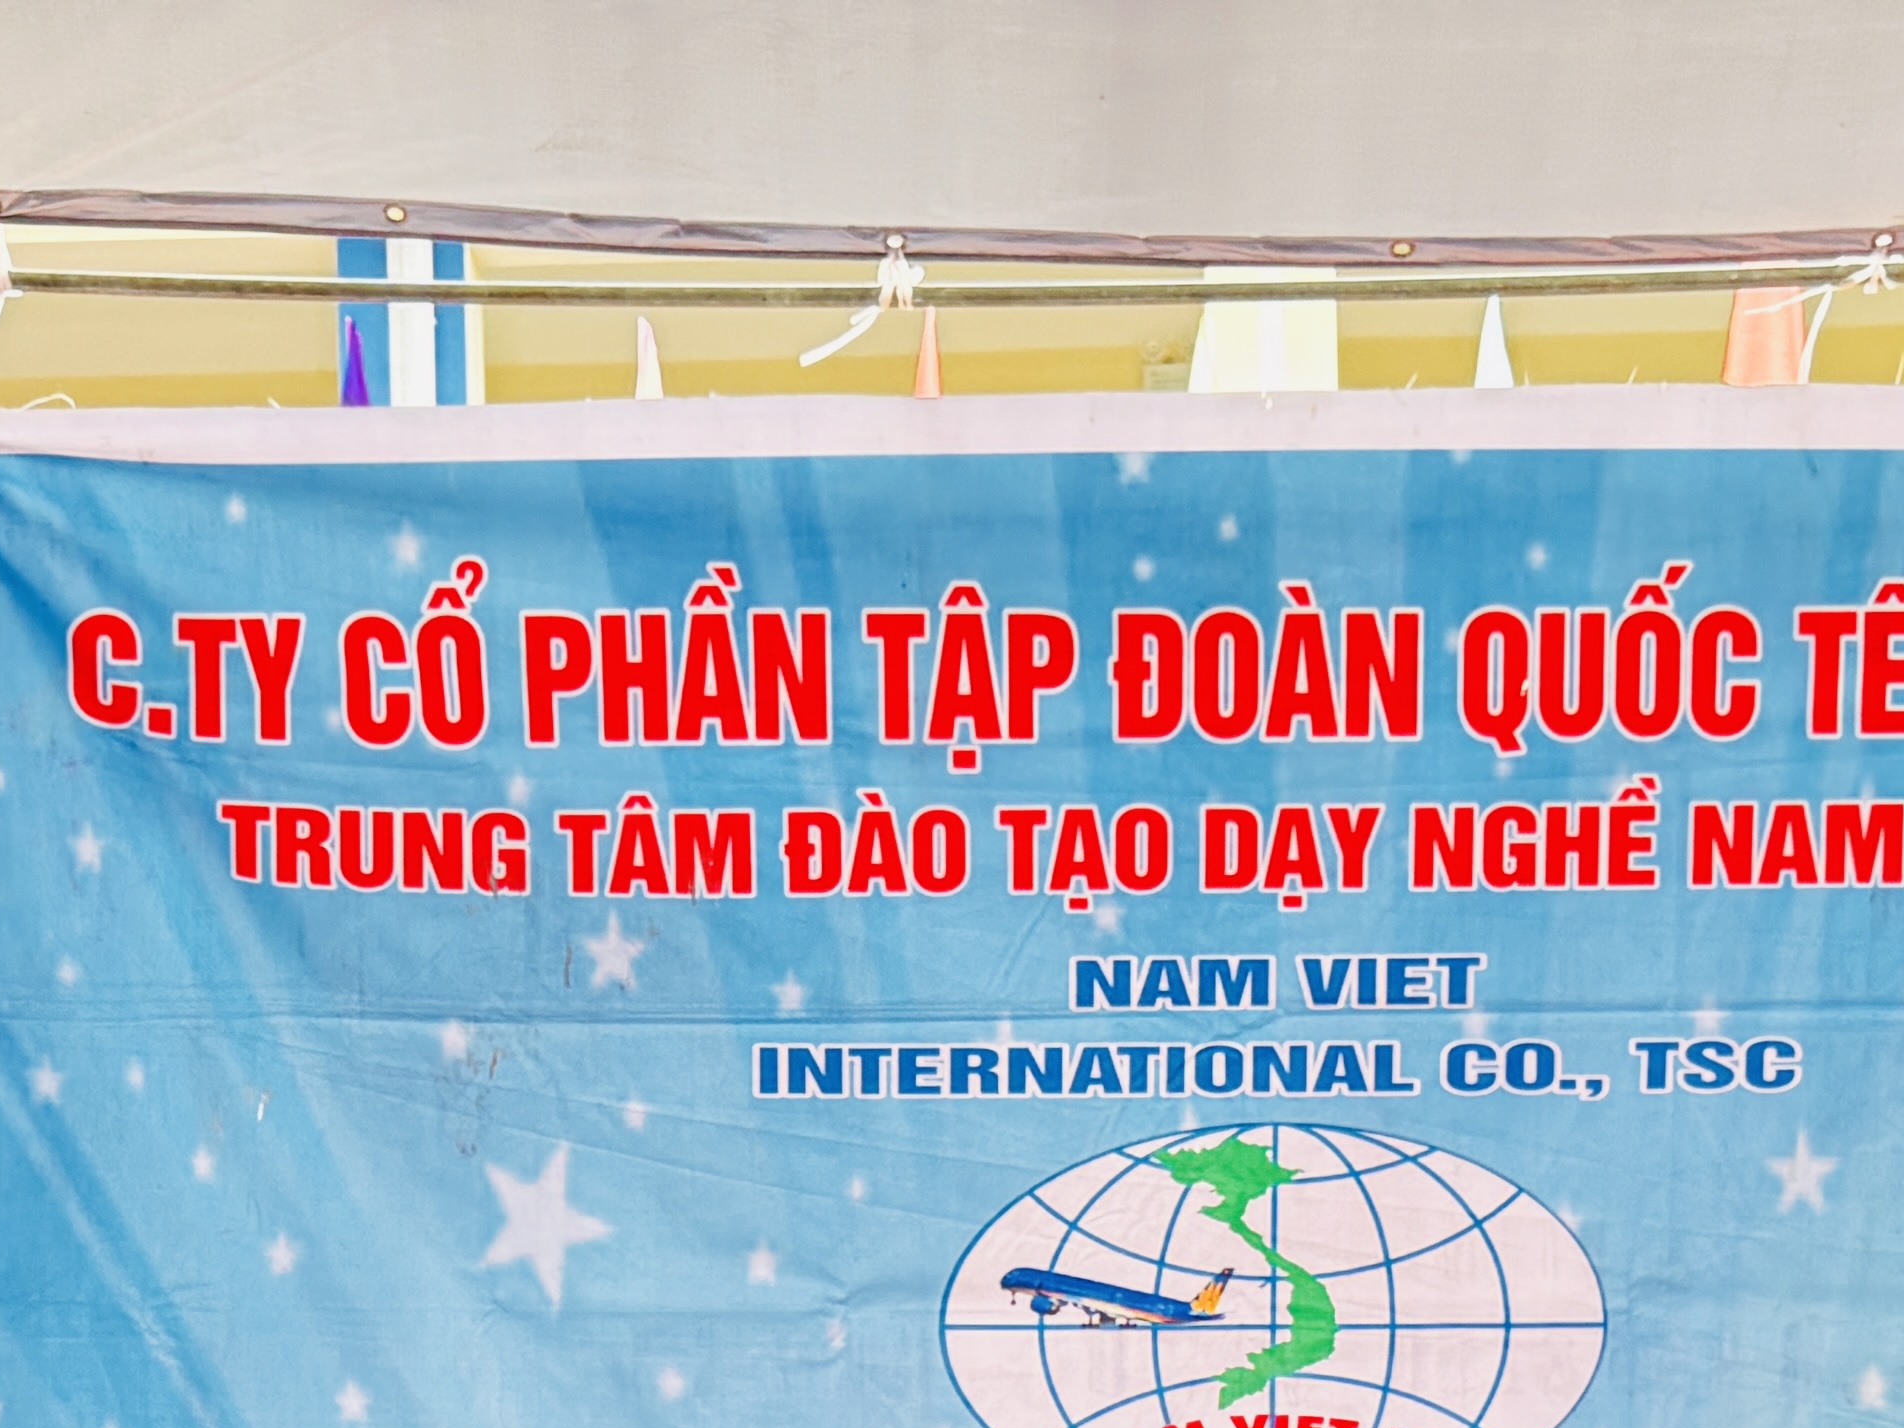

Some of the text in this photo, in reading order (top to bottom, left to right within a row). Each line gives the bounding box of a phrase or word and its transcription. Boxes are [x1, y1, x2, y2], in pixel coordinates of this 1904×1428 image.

[72, 615, 300, 739] C.TY
[345, 561, 484, 744] CỔ
[525, 569, 827, 742] PHẦN
[867, 587, 1073, 768] TẬP
[1114, 587, 1418, 738] ĐOÀN
[1464, 567, 1756, 751] QUỐC
[222, 805, 525, 890] TRUNG
[560, 796, 751, 893] TÂM
[785, 794, 965, 892] ĐÀO
[1000, 809, 1167, 909] TẠO
[1205, 809, 1378, 906] DẠY
[1414, 778, 1655, 887] NGHỀ
[1693, 805, 1903, 884] NAM
[1077, 958, 1479, 1006] NAM VIET
[761, 1042, 1794, 1094] INTERNATIONAL CO., TSC
